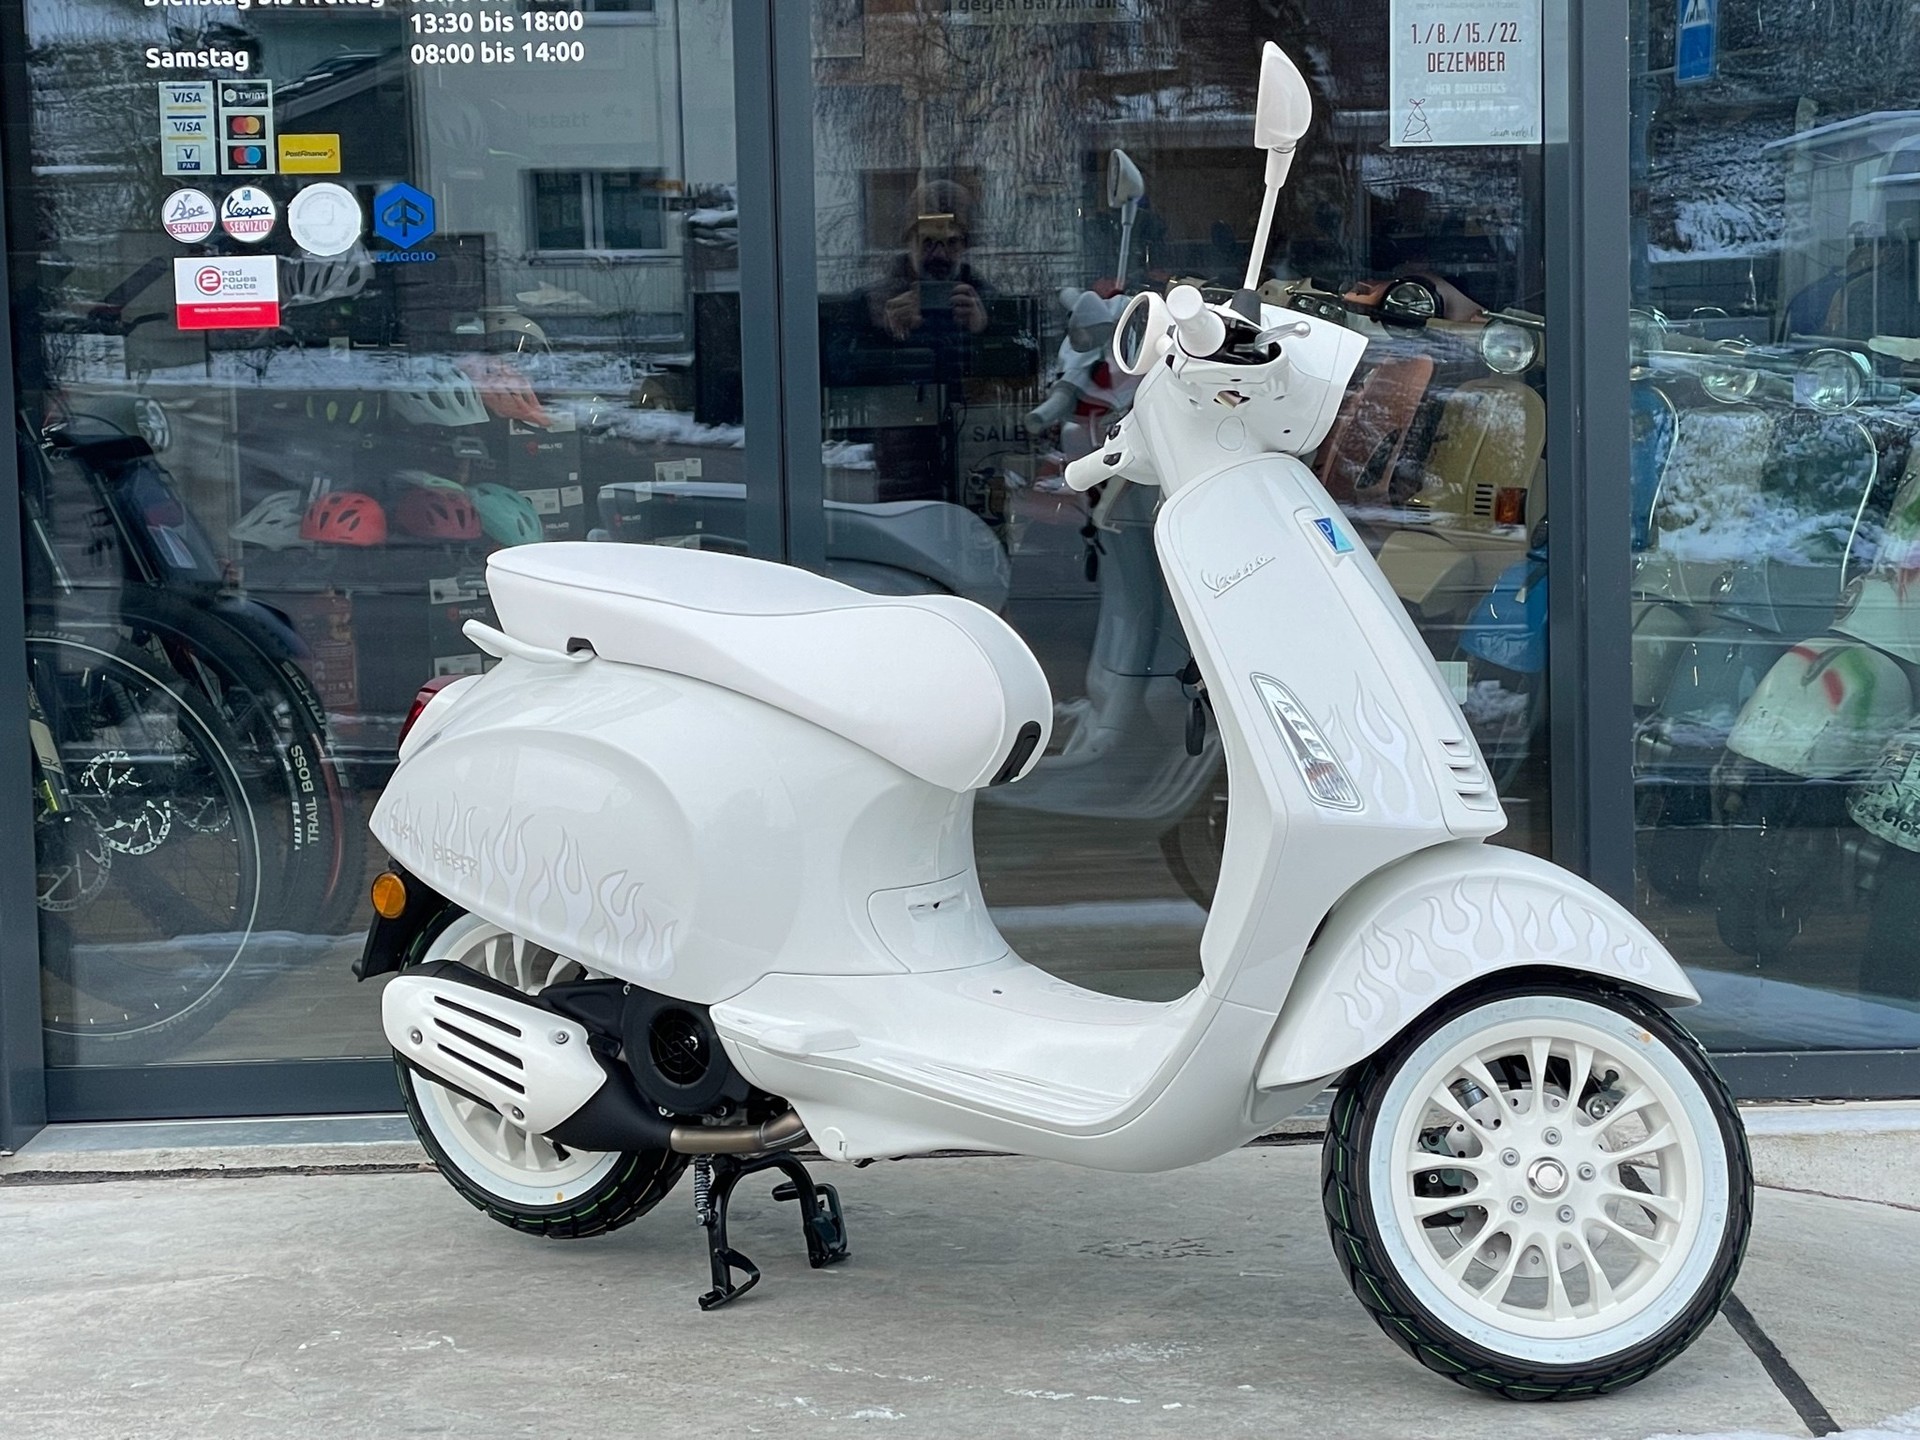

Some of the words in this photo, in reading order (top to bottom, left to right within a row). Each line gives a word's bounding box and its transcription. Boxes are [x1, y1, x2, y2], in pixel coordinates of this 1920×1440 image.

[410, 13, 474, 34] 13:30
[479, 11, 514, 33] bis
[521, 10, 584, 32] 18:00
[145, 48, 249, 70] Samstag
[410, 43, 475, 64] 08:00
[480, 41, 515, 63] bis
[522, 41, 585, 63] 14:00
[1427, 51, 1505, 72] DEZEMBER
[172, 92, 202, 103] VISA
[173, 121, 202, 132] VISA
[183, 148, 194, 160] V
[169, 199, 209, 222] Ape
[225, 195, 272, 219] Vespa
[172, 222, 209, 234] SERVIZIO
[228, 220, 269, 232] SERVIZIO
[376, 251, 436, 263] PIAGGIO
[222, 268, 243, 276] rad
[290, 744, 315, 793] BOSS
[306, 796, 320, 844] TRAIL
